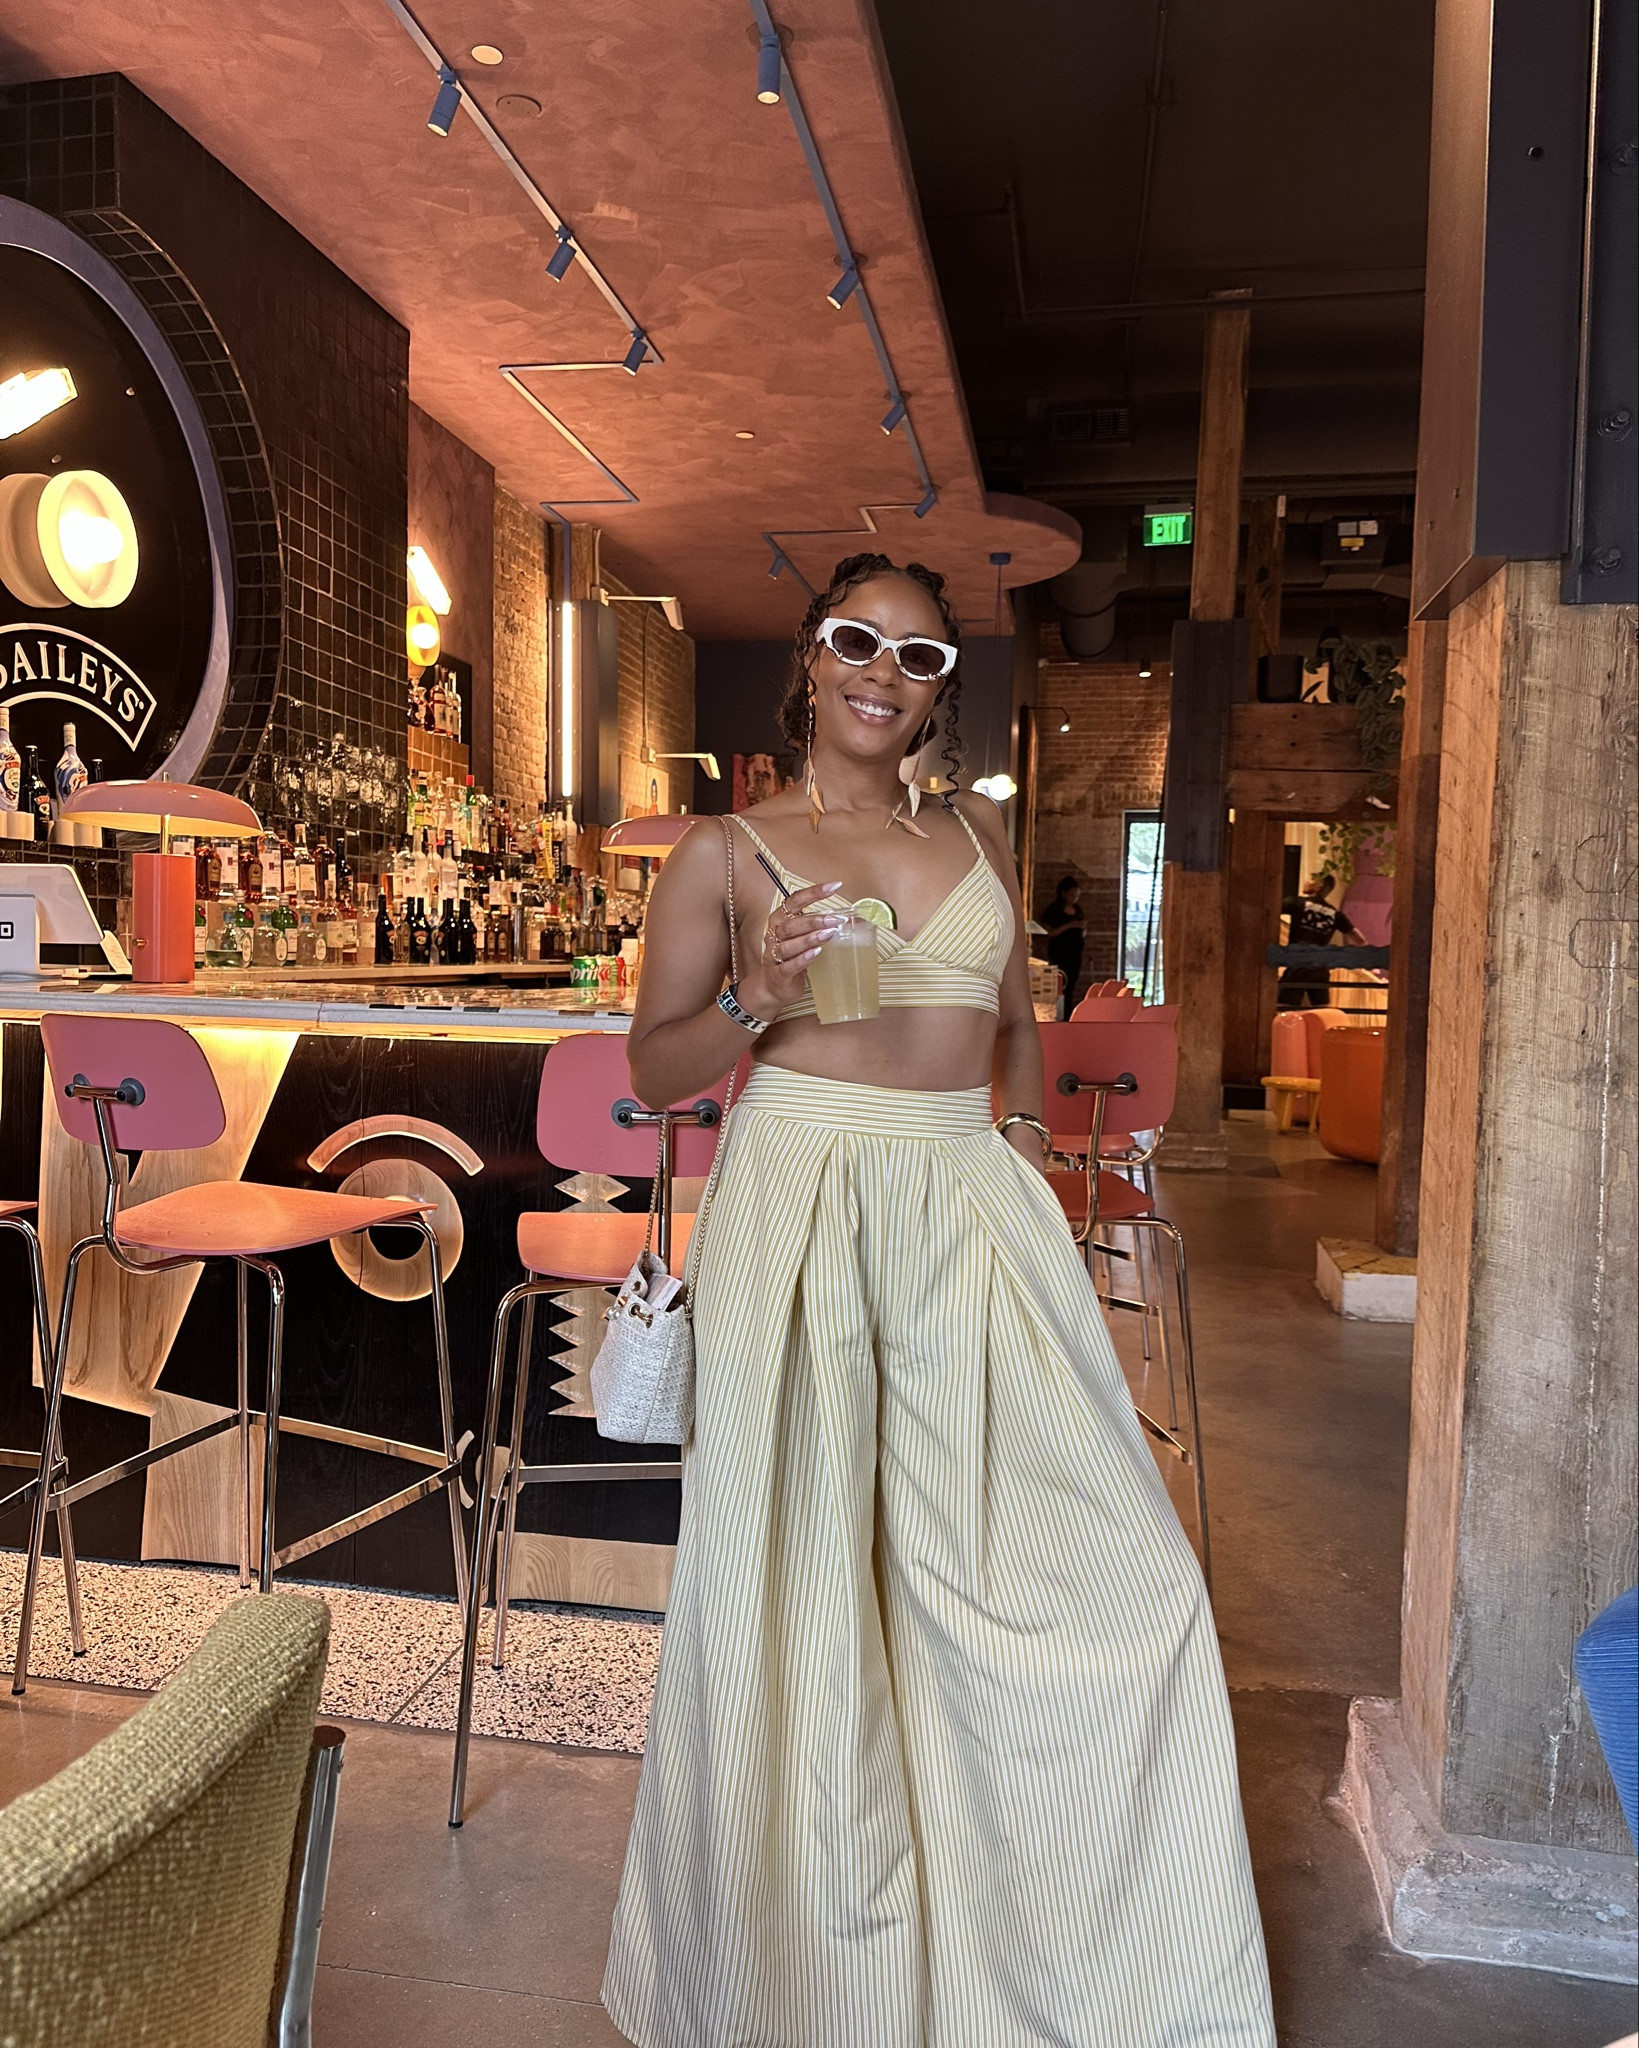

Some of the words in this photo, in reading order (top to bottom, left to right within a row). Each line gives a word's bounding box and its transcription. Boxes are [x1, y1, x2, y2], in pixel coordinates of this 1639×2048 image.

[1152, 515, 1186, 543] EXIT
[570, 964, 599, 984] prit
[739, 1014, 762, 1030] 21
